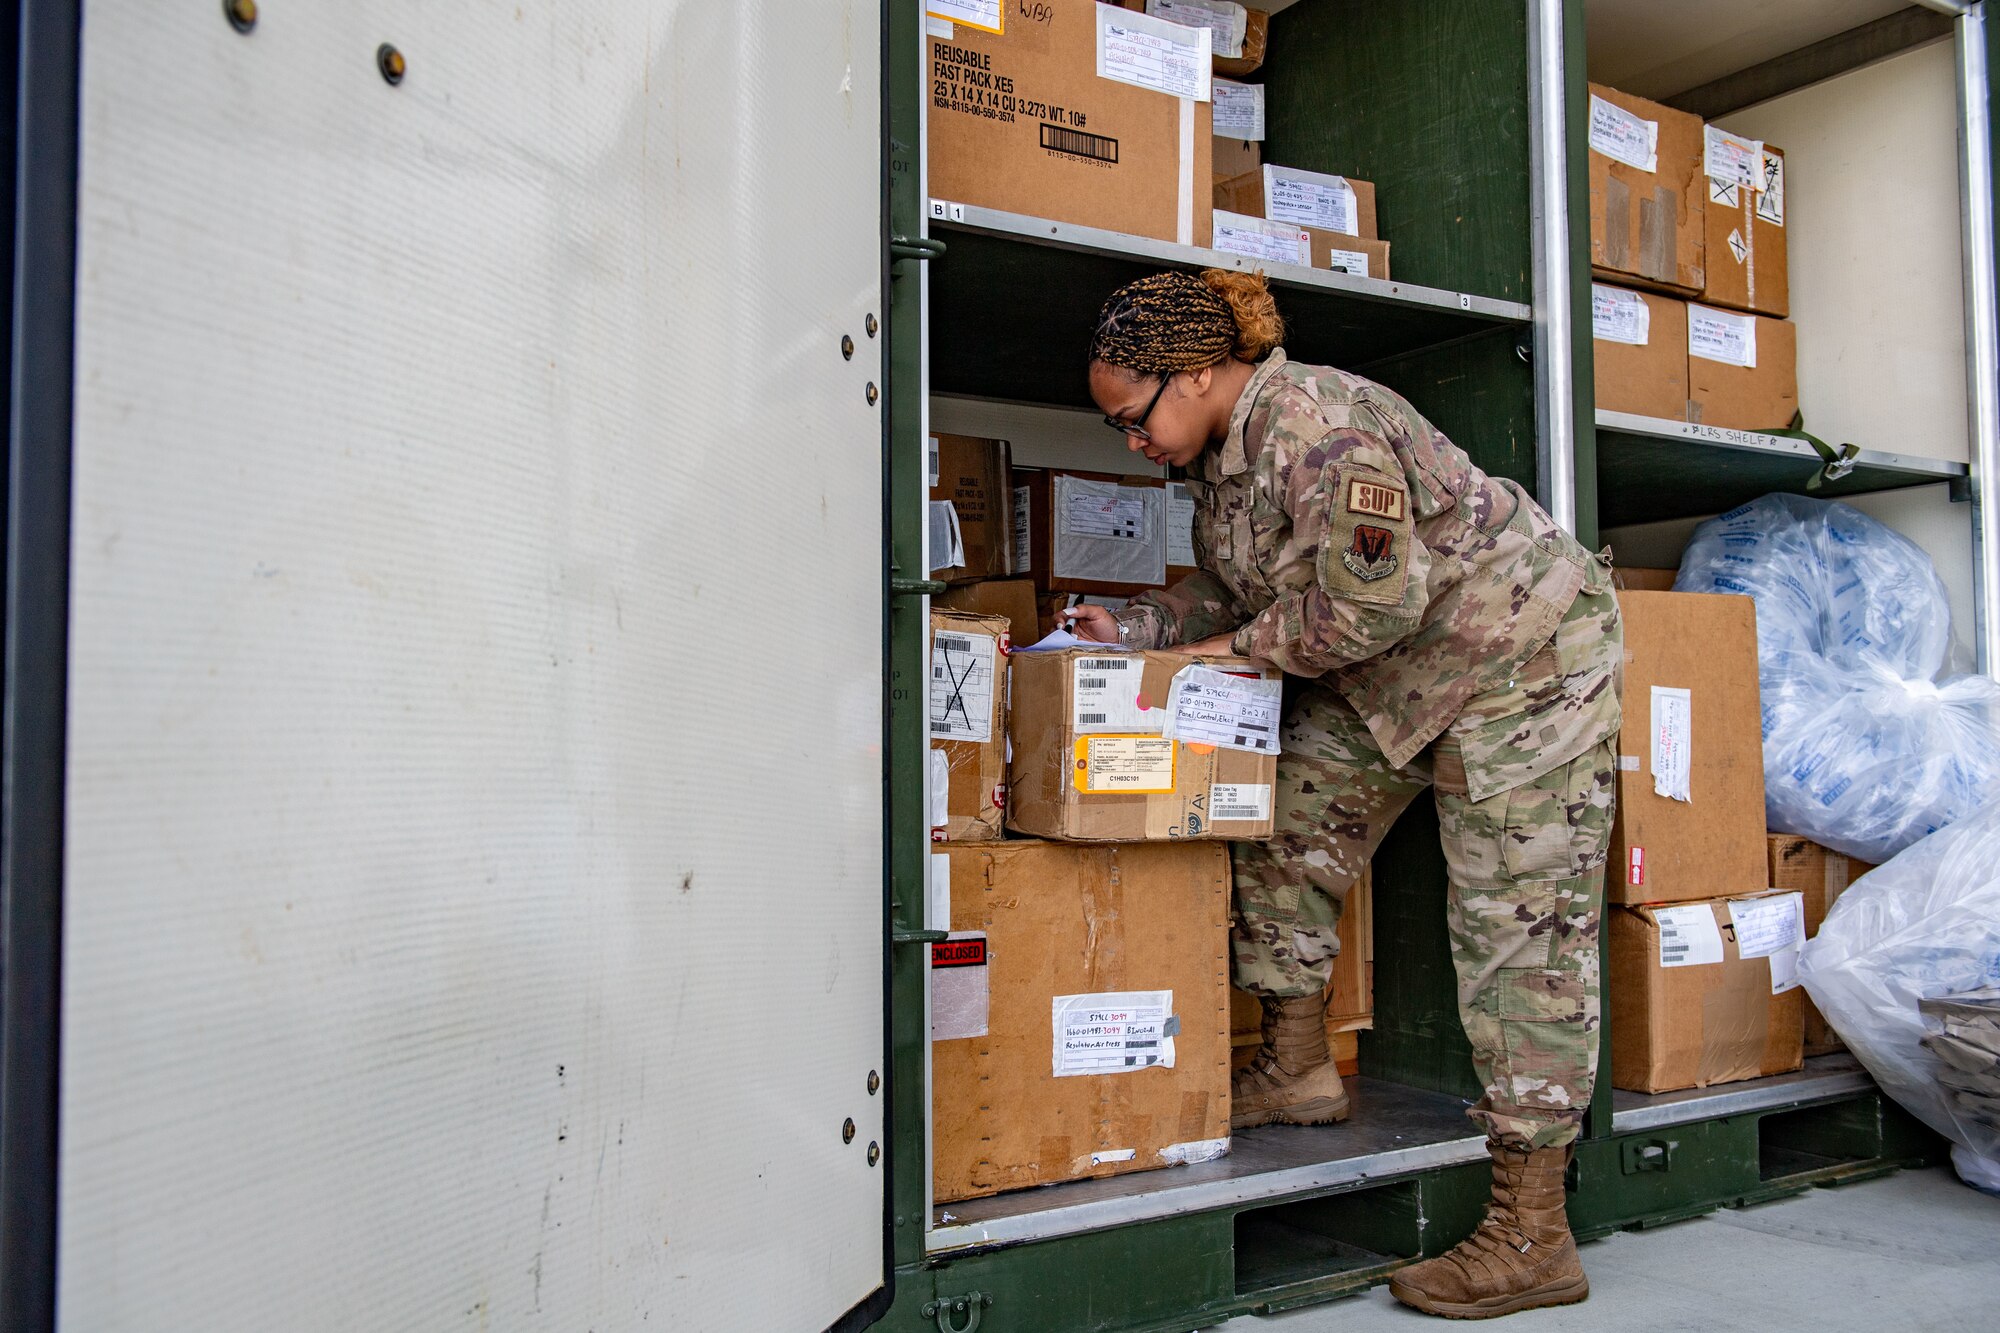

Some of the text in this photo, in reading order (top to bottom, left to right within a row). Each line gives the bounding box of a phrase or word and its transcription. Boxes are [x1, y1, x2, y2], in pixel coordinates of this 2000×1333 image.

[934, 43, 991, 71] REUSABLE
[934, 61, 1014, 94] FAST PACK XE5
[934, 80, 1086, 128] 25 X 14 X 14 CU 3.273 WT. 10#
[934, 96, 1015, 123] NSN-8115-00-550-3574
[1047, 150, 1112, 169] 8115-00-550-3574
[935, 204, 960, 219] B 1
[1462, 297, 1468, 307] 3
[1700, 427, 1766, 445] LRS SHELF
[1358, 485, 1395, 513] SUP
[932, 945, 980, 960] ENCLOSED
